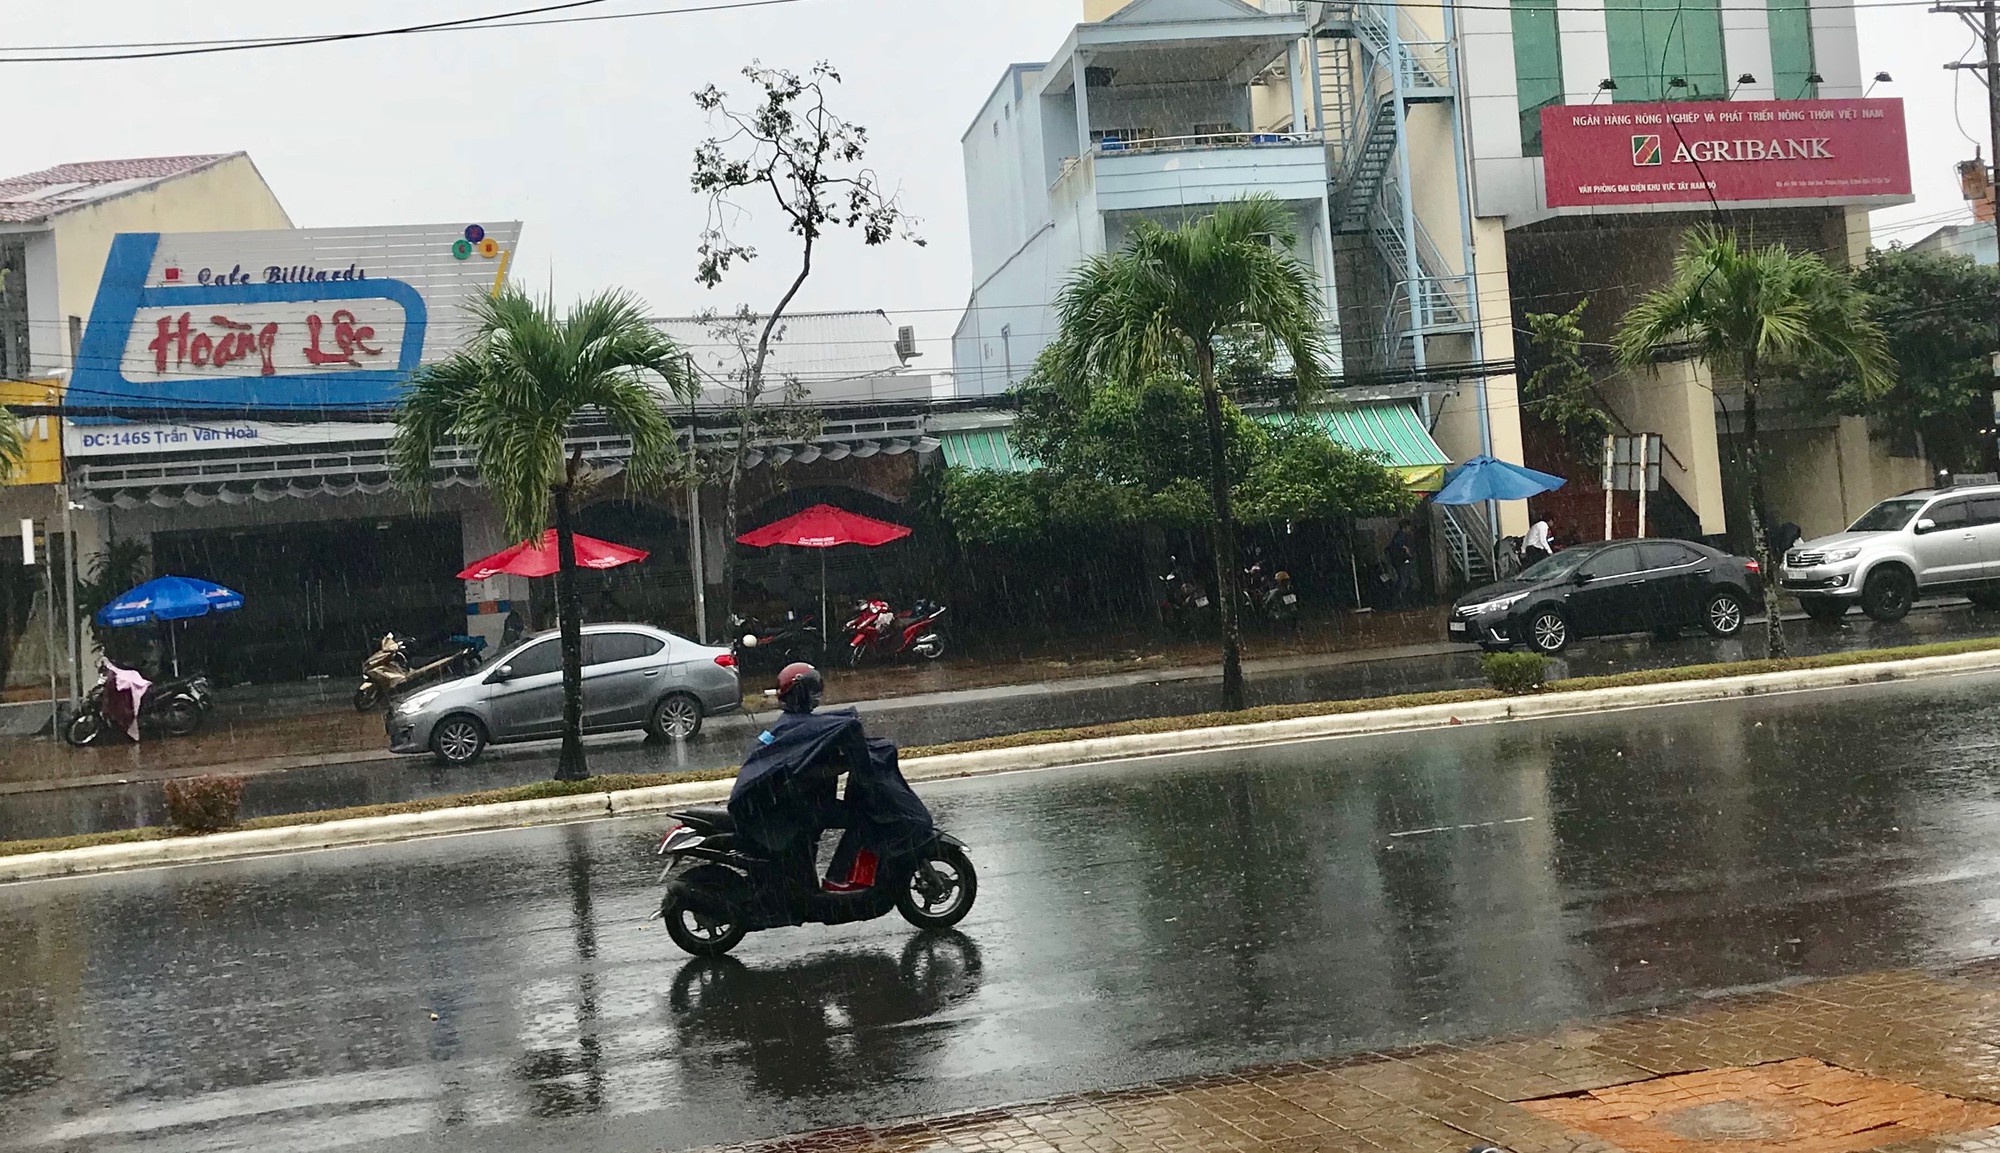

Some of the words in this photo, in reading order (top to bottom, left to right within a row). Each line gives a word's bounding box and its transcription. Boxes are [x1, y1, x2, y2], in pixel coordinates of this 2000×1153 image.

[1572, 113, 1600, 126] NGÂN
[1604, 112, 1631, 126] HÀNG
[1635, 112, 1662, 125] NÔNG
[1704, 110, 1716, 123] VÀ
[1719, 109, 1743, 122] PHÁT
[1747, 108, 1774, 121] TRIỂN
[1778, 109, 1805, 121] NÔNG
[1808, 108, 1834, 120] THÔN
[1838, 107, 1858, 120] VIỆT
[1862, 109, 1885, 119] NAM
[1671, 138, 1835, 163] AGRIBANK
[198, 264, 250, 287] Cafe
[264, 263, 365, 284] Billiards
[148, 311, 279, 377] Hoàng
[303, 309, 383, 368] Lộc
